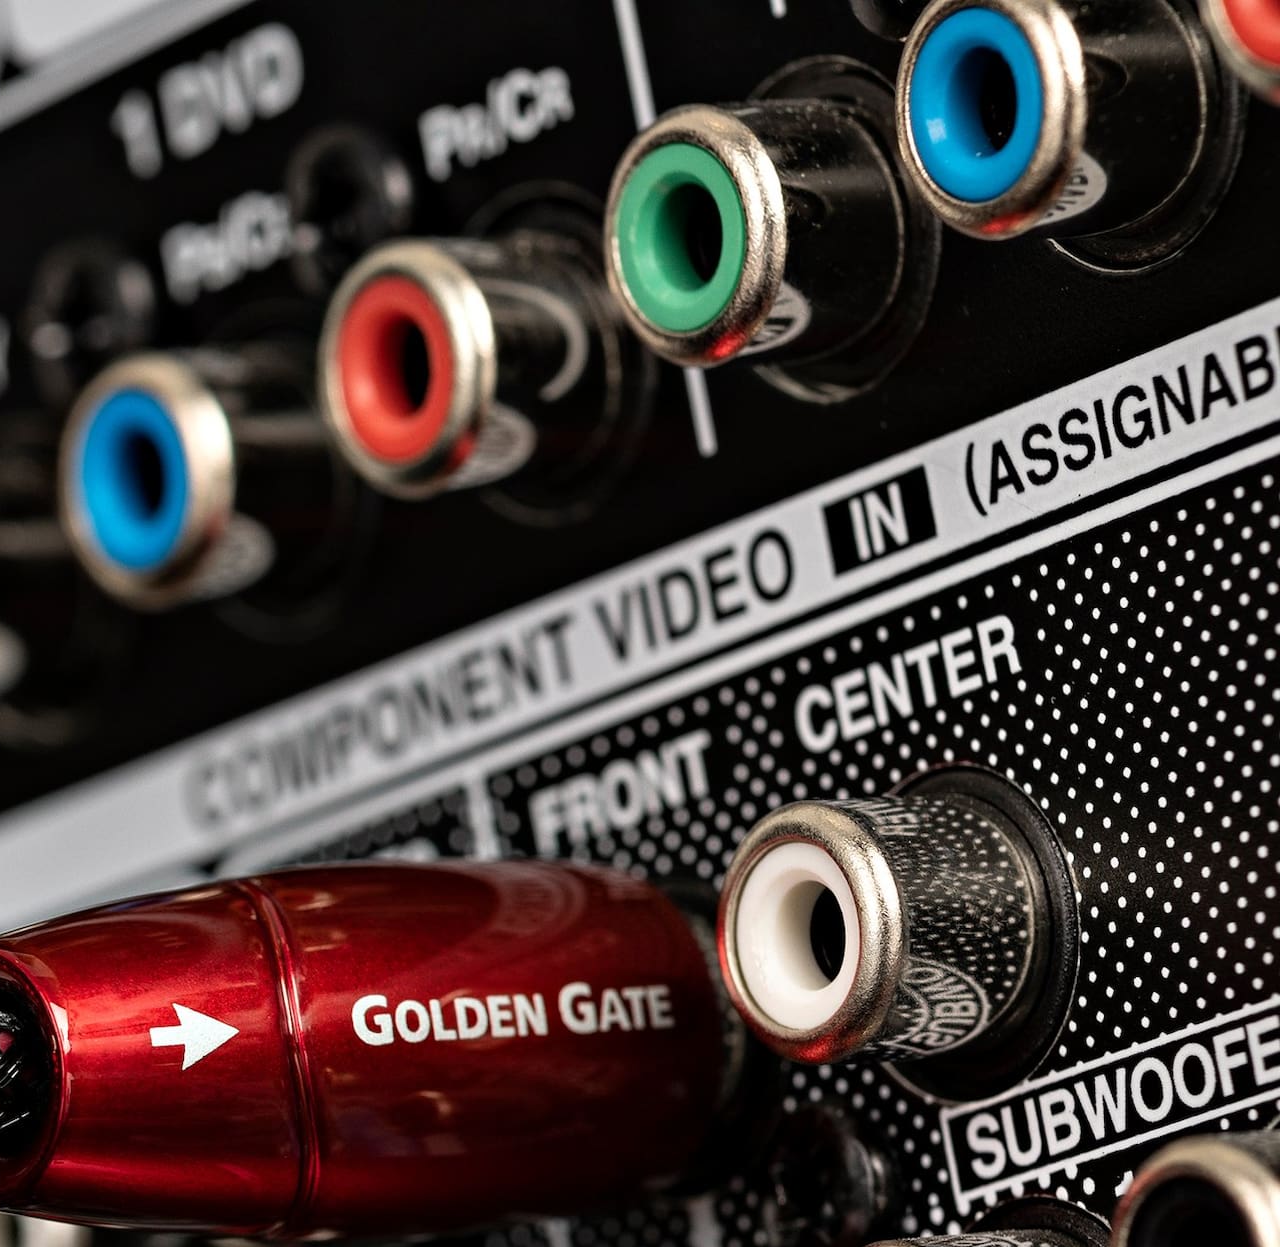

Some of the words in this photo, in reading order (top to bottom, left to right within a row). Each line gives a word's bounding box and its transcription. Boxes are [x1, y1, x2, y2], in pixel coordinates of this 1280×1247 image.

[113, 92, 162, 178] 1
[159, 23, 303, 159] DVD
[180, 613, 577, 828] COMPONENT
[595, 527, 795, 662] VIDEO
[849, 490, 910, 562] IN
[965, 328, 1280, 516] (ASSIGNAB
[794, 614, 1024, 753] CENTER
[530, 730, 711, 858] FRONT
[351, 993, 548, 1047] GOLDEN
[557, 982, 674, 1035] GATE
